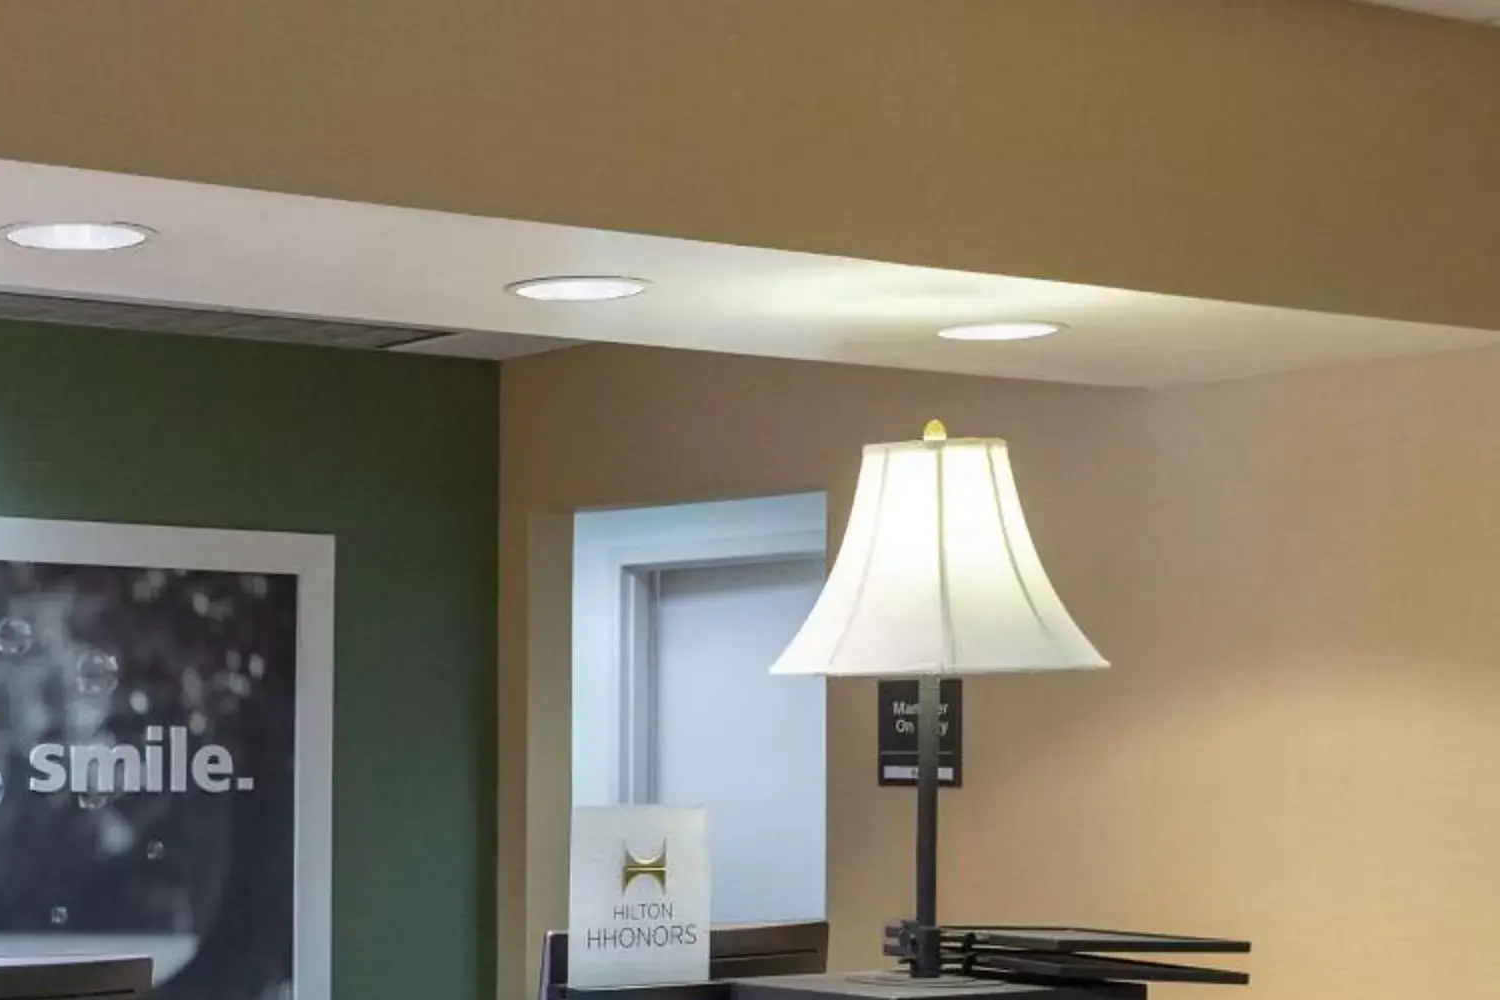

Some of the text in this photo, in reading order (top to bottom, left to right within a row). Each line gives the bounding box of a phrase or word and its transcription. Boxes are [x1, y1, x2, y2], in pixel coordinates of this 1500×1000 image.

[892, 700, 949, 716] Maner
[895, 719, 915, 734] On
[29, 725, 255, 793] smile.
[612, 902, 674, 921] HILTON
[586, 923, 697, 951] HHONORS
